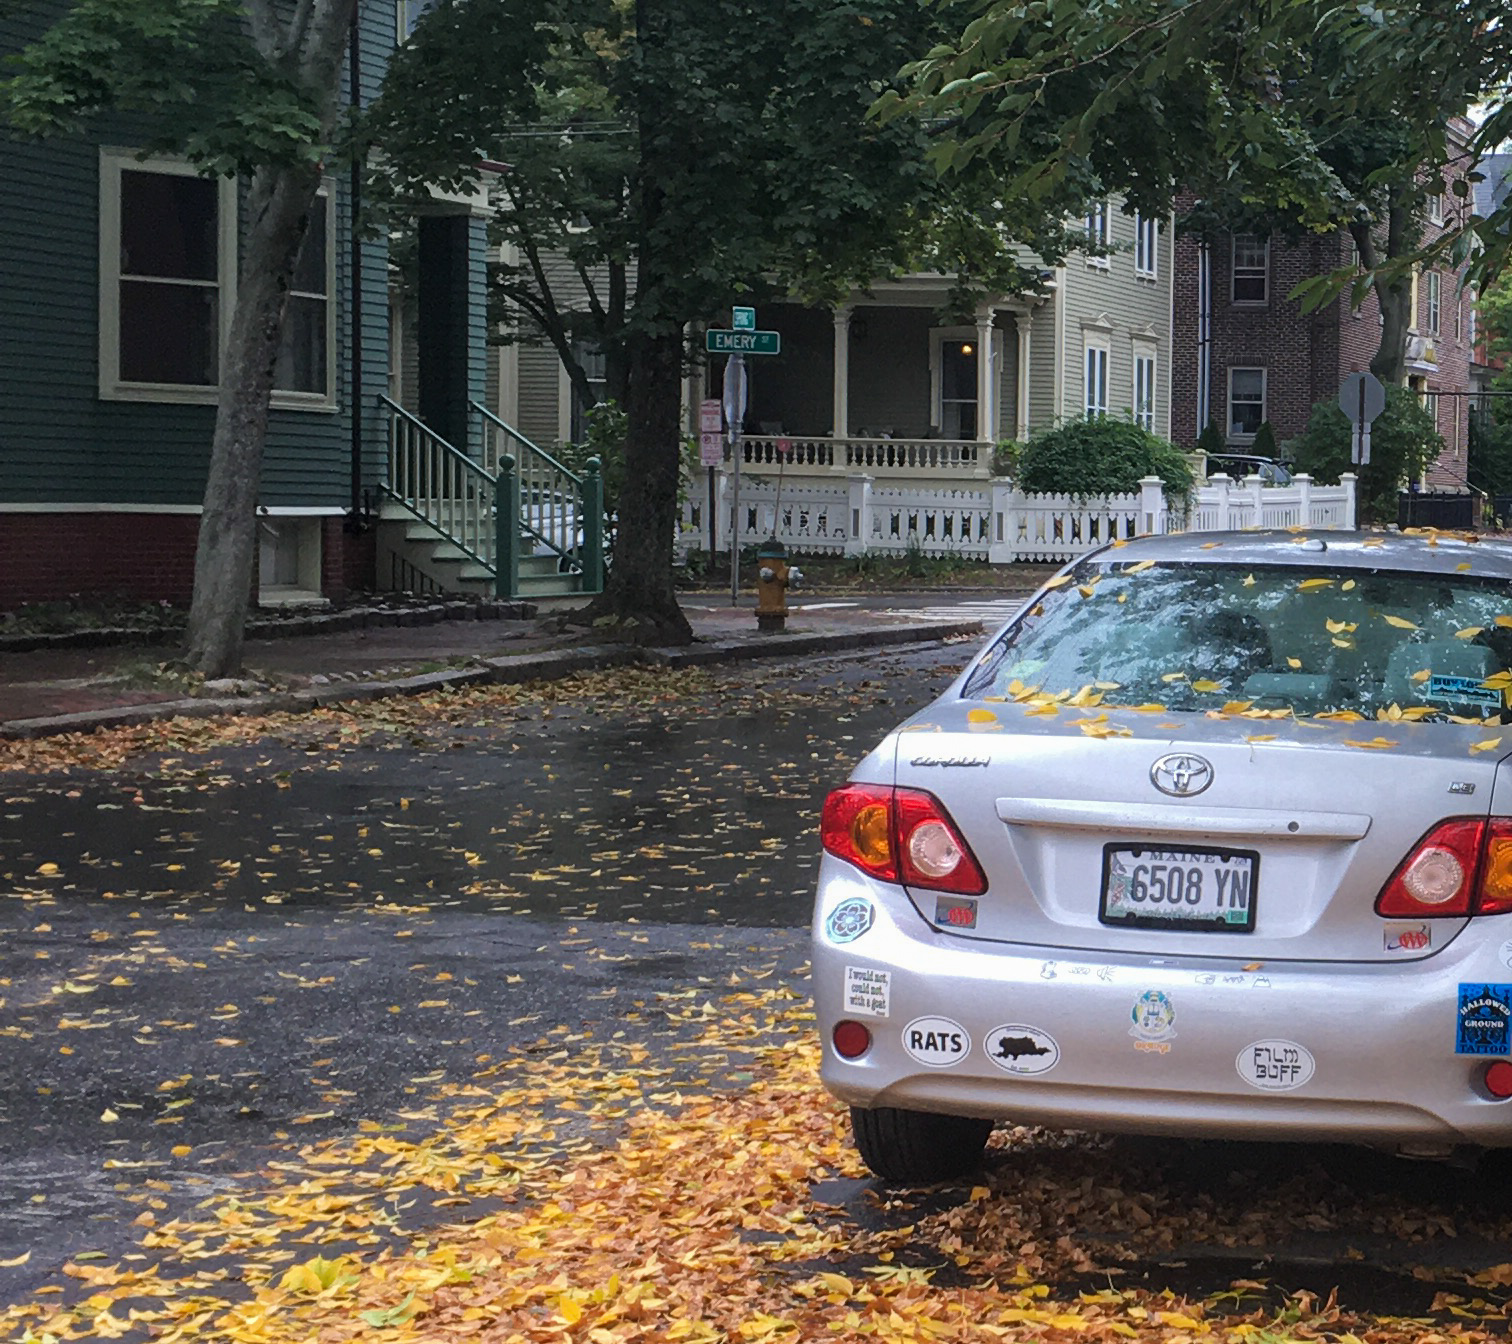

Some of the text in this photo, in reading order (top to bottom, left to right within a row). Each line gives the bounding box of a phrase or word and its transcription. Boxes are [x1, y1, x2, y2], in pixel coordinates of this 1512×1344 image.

[716, 334, 770, 349] EMERY ST
[1149, 851, 1216, 864] MAINE
[1131, 864, 1249, 908] 6508 YN
[848, 967, 853, 980] I
[853, 969, 874, 982] would
[851, 982, 870, 994] could
[849, 994, 865, 1007] with
[871, 998, 886, 1011] goat
[1459, 998, 1511, 1016] HALLOWED
[1464, 1019, 1505, 1028] GROUND
[910, 1030, 962, 1053] RATS
[1459, 1044, 1509, 1054] TATTOO
[1253, 1046, 1299, 1066] FILM
[1255, 1064, 1302, 1083] BUFF
